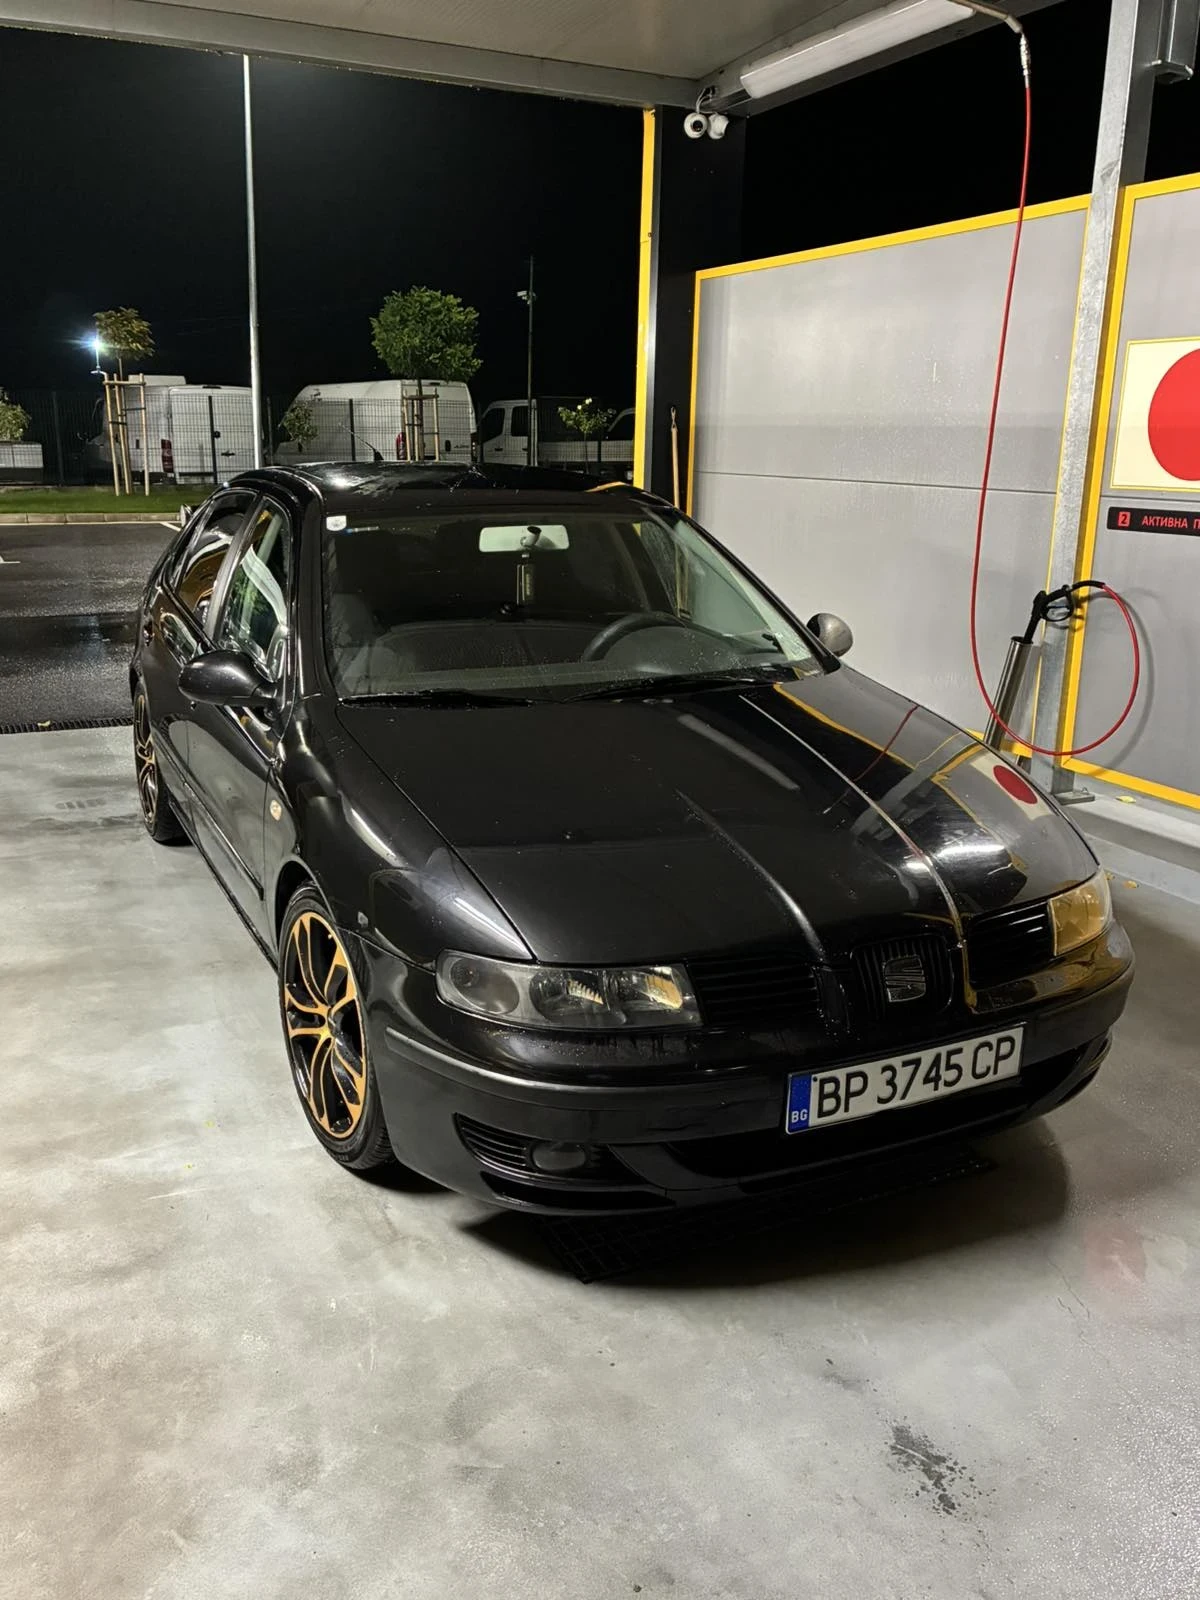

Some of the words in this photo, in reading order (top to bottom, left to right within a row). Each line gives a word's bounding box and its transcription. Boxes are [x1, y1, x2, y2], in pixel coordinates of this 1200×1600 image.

[1141, 515, 1188, 529] АКТИВНА
[817, 1070, 868, 1118] BP
[877, 1048, 963, 1105] 3745
[970, 1035, 1016, 1080] CP
[791, 1110, 808, 1123] BG
